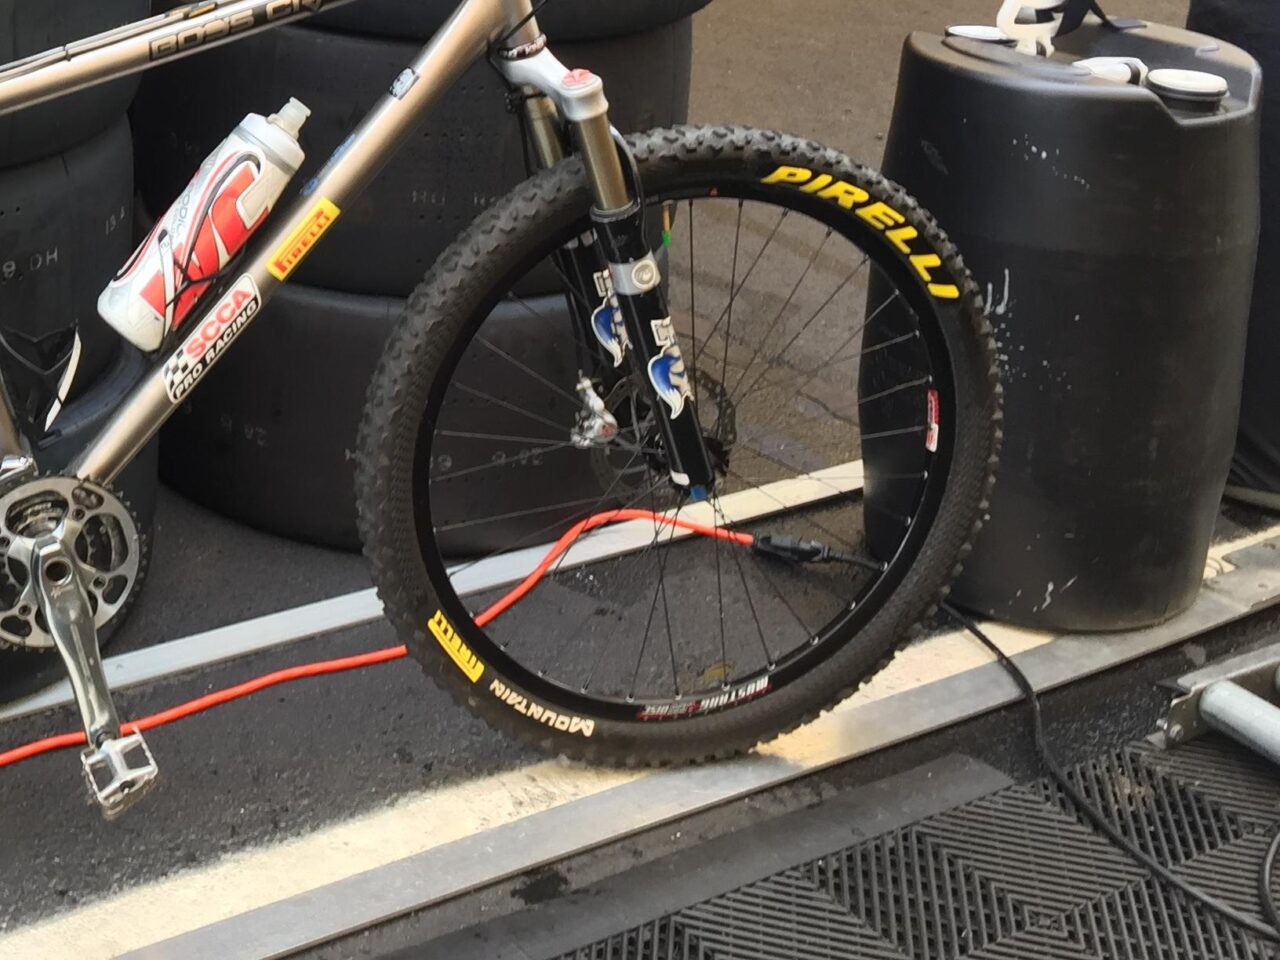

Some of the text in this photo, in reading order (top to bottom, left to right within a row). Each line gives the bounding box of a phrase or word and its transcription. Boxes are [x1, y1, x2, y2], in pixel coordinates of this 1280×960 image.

[274, 207, 331, 275] PIRELLI
[760, 164, 962, 300] PIRELLI
[175, 300, 258, 398] PRO RACING
[185, 287, 252, 360] SCCA
[426, 609, 595, 738] MOUNTAIN PIRELLI
